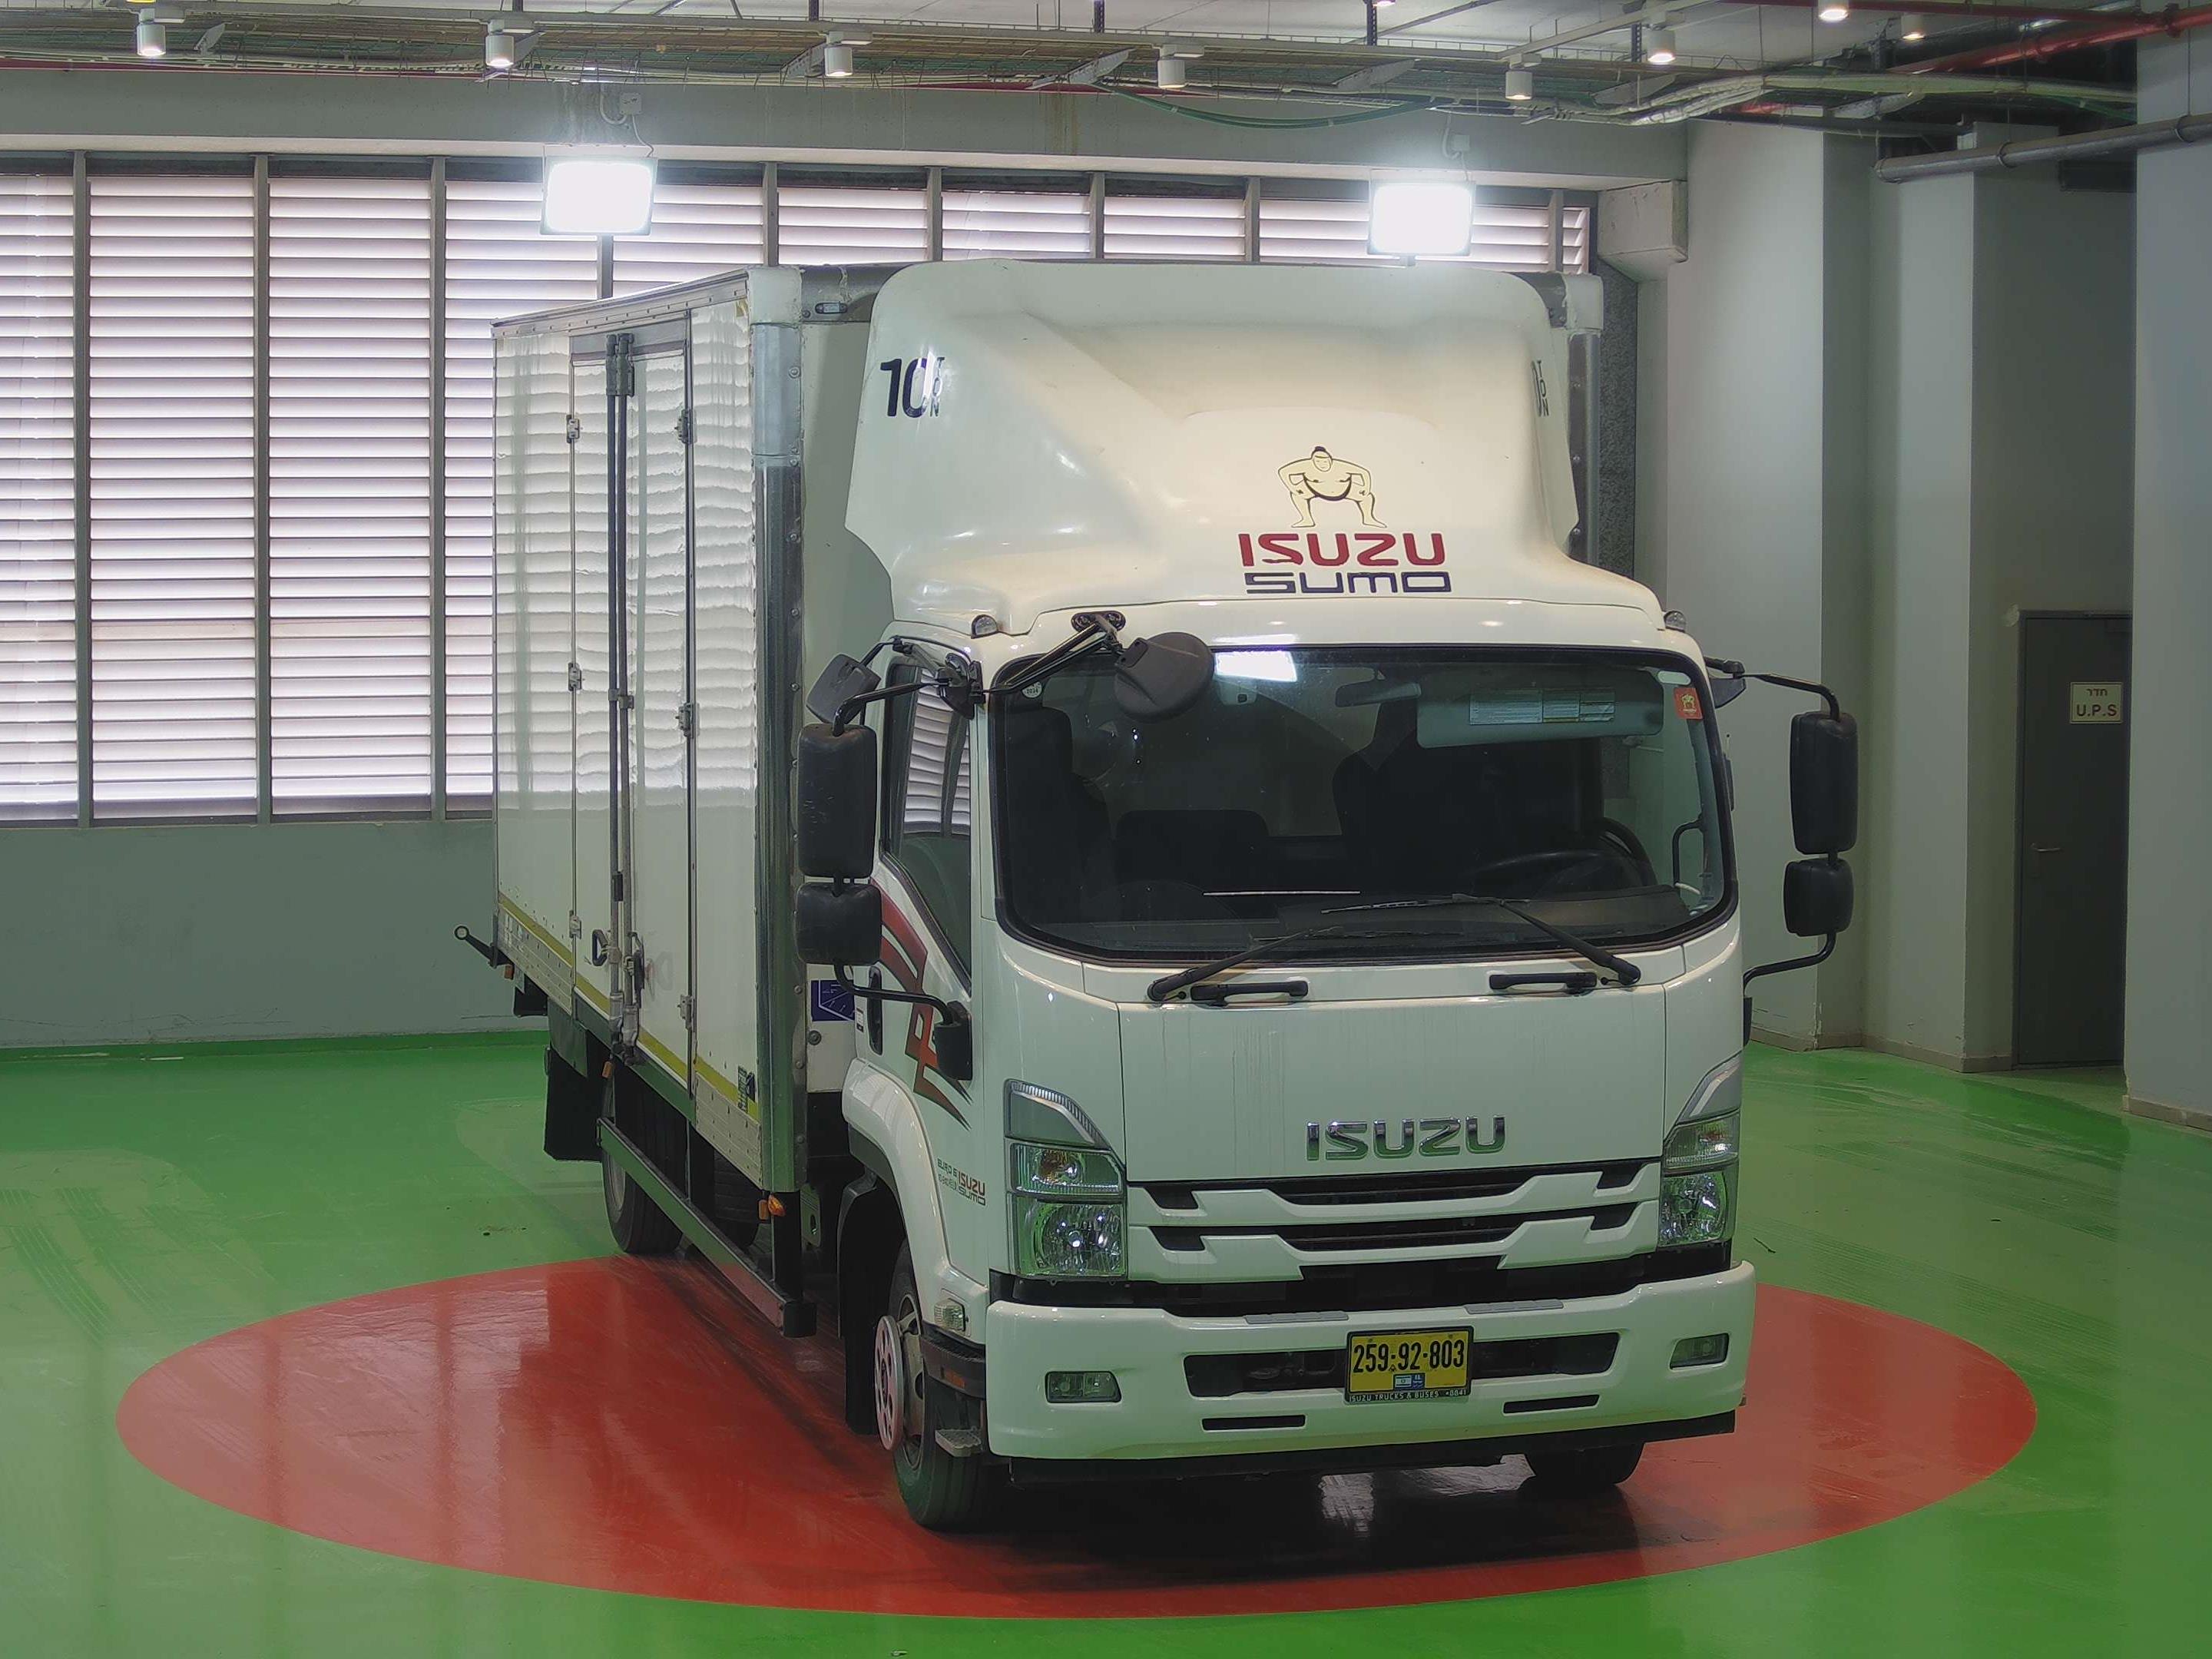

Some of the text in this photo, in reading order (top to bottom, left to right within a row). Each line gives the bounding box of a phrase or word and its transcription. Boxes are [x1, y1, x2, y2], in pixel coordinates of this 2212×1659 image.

[880, 358, 929, 418] 10
[1537, 359, 1549, 416] TON
[1237, 533, 1445, 567] ISUZU
[2086, 688, 2108, 697] חדר
[2076, 704, 2118, 717] U.P.S
[1306, 1115, 1506, 1161] ISUZU
[958, 1171, 985, 1197] ISUZU
[1375, 1392, 1404, 1401] TRUCKS
